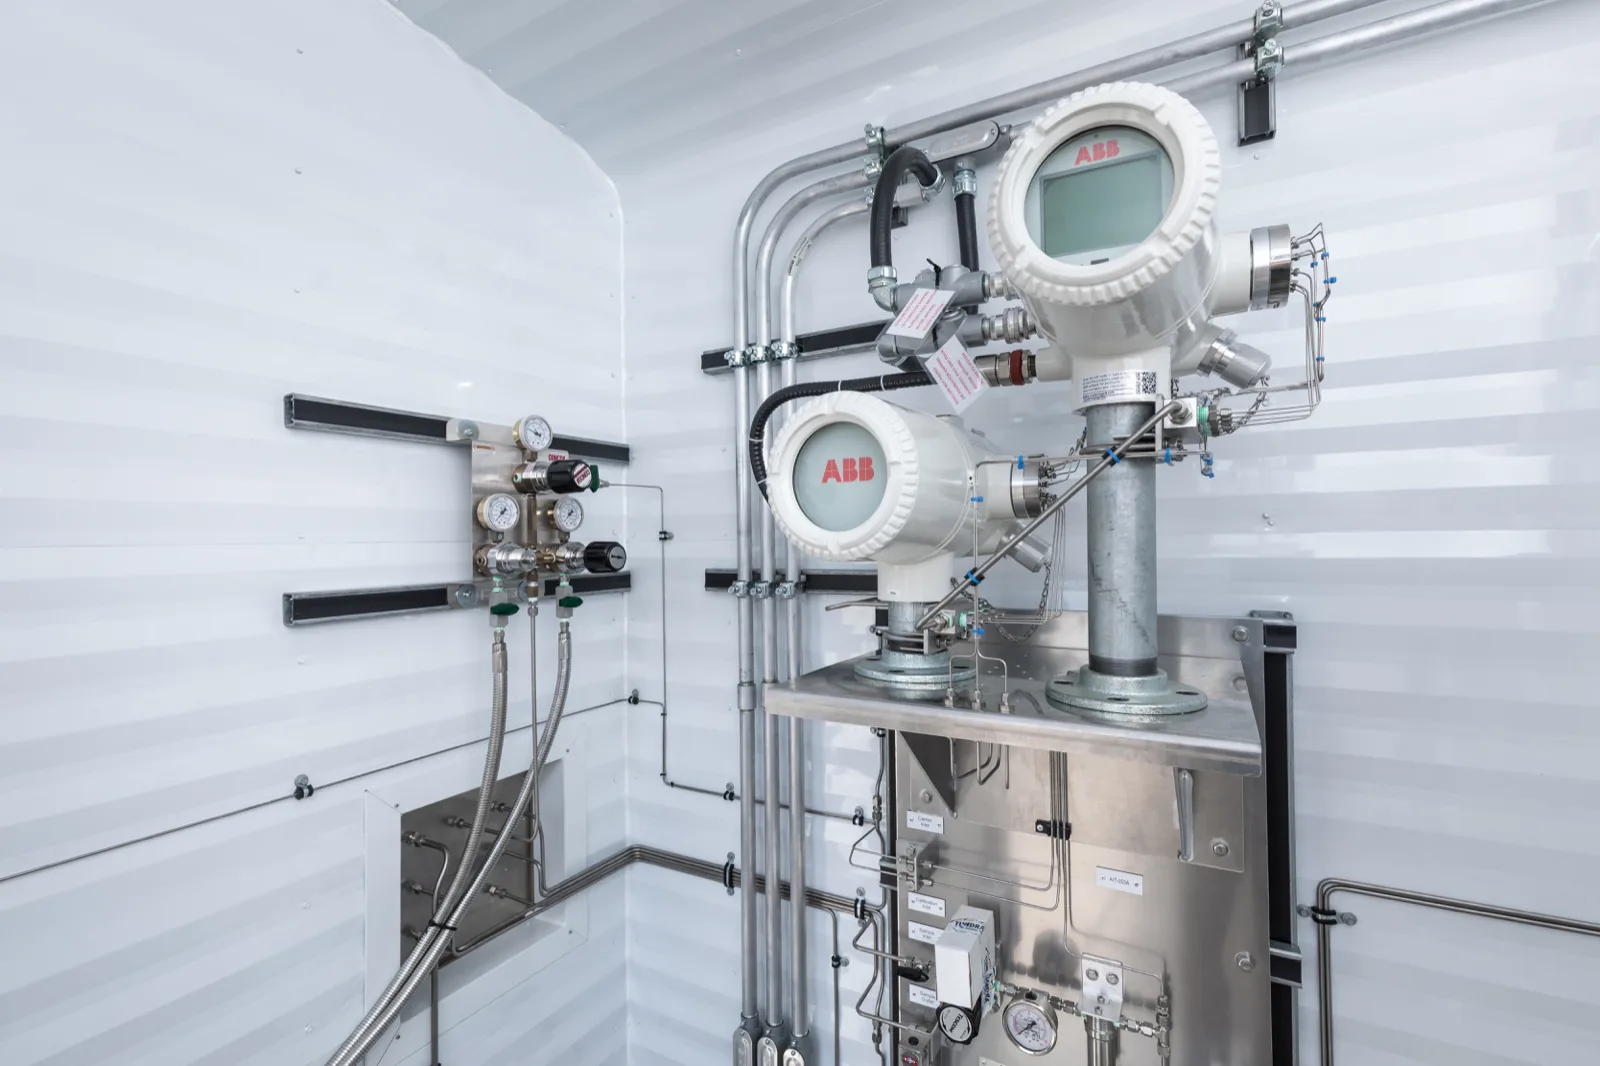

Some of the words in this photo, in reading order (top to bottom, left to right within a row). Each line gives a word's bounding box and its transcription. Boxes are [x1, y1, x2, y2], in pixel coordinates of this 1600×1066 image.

[1074, 139, 1120, 166] ABB
[821, 456, 875, 484] ABB
[955, 921, 984, 934] TUNDRA
[949, 1013, 964, 1033] TESCOM
